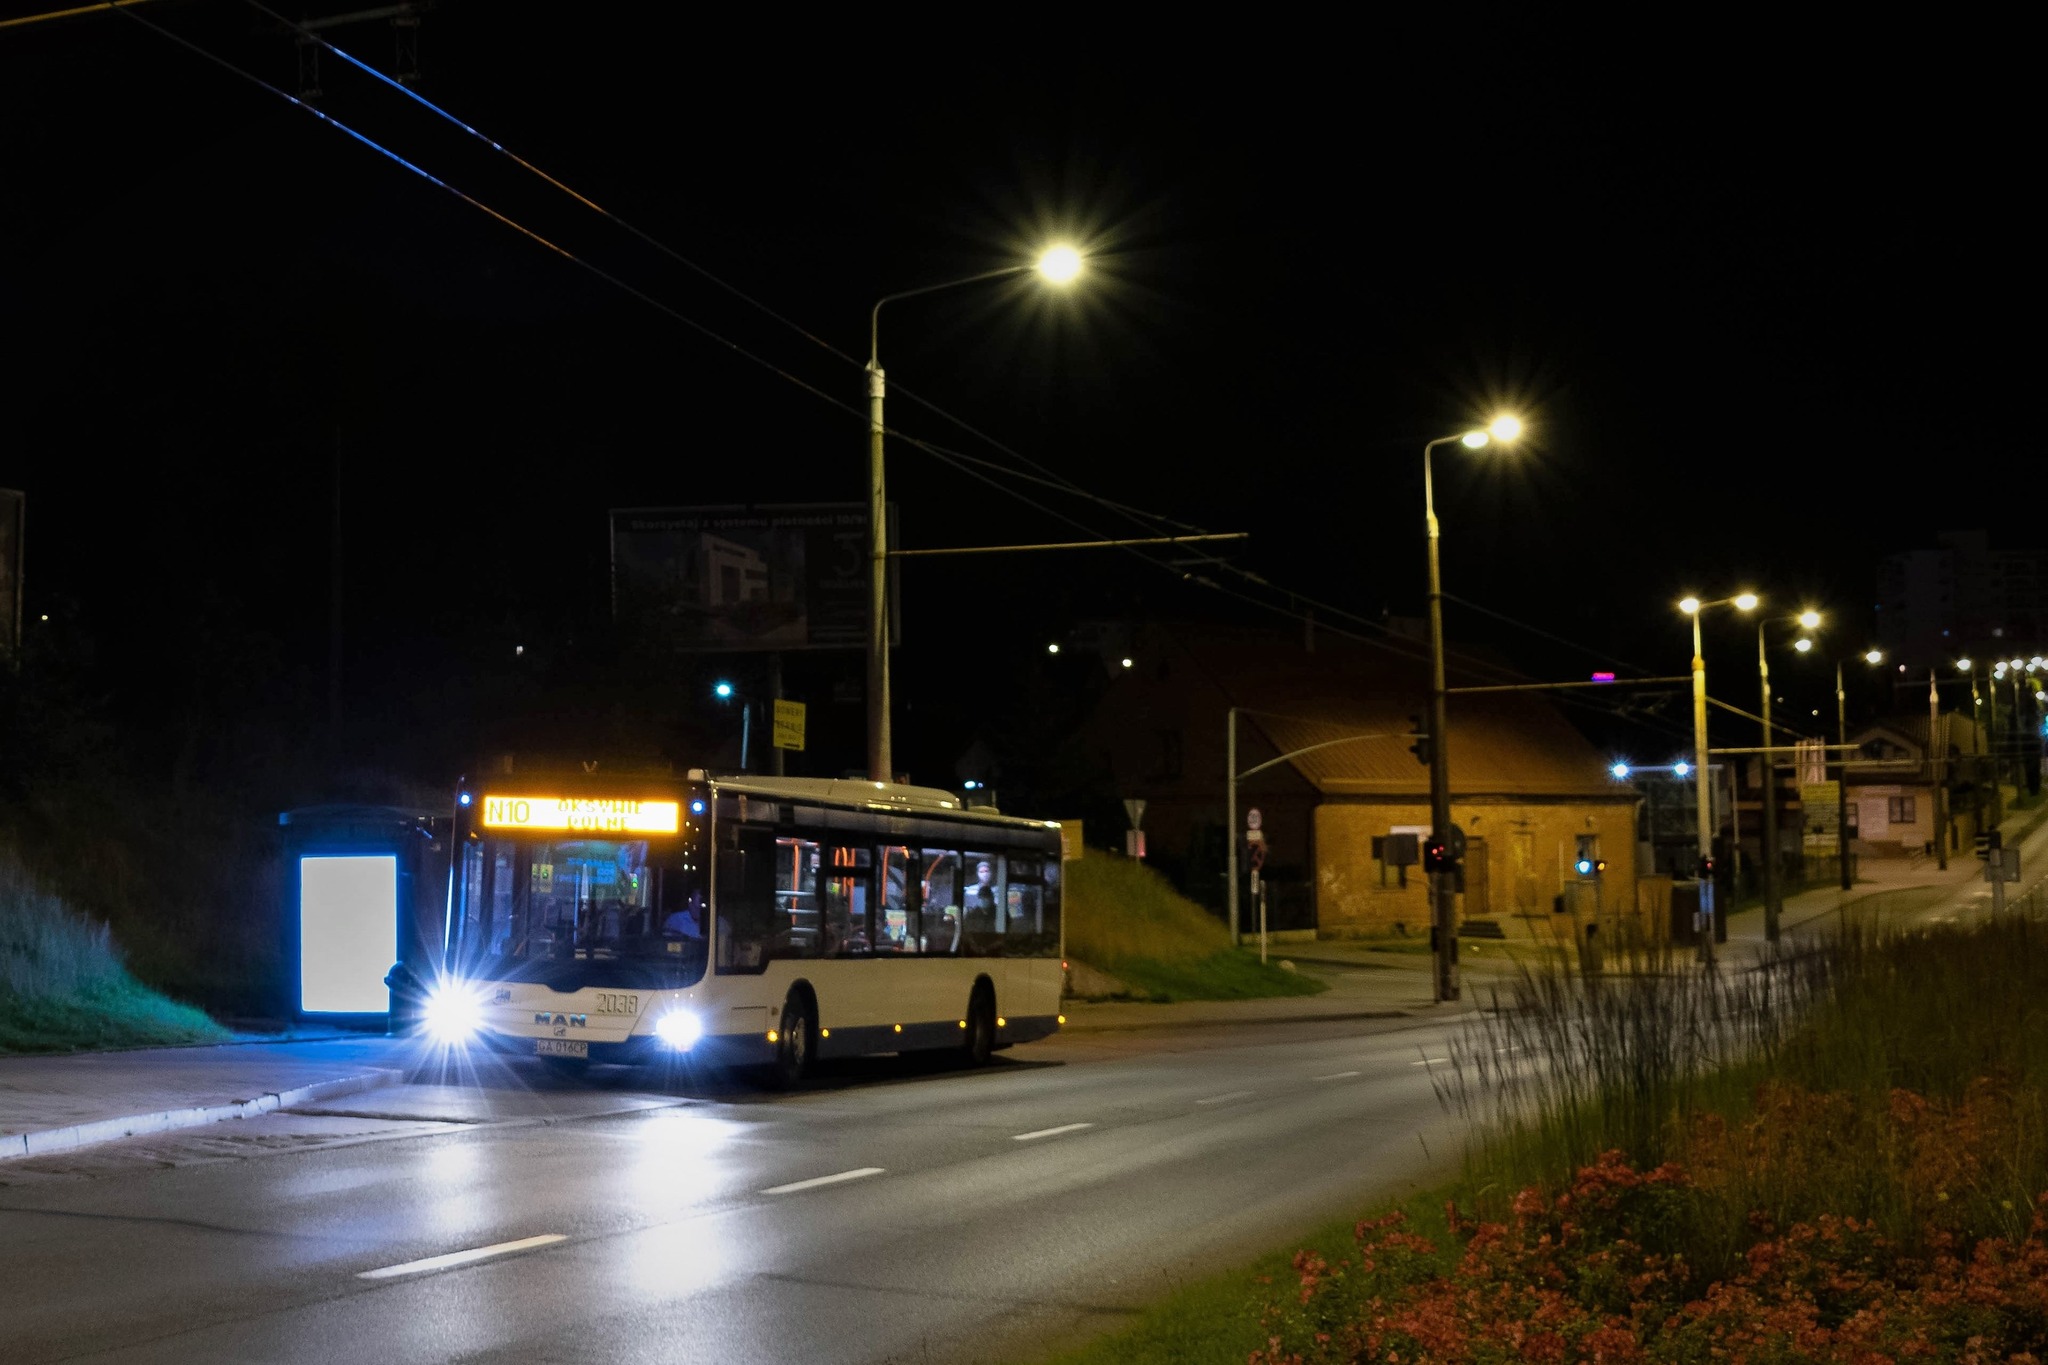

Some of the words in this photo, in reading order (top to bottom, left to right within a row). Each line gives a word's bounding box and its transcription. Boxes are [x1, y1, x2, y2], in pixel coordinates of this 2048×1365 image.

[713, 518, 768, 530] systemu
[488, 799, 530, 824] N10
[534, 1011, 587, 1028] MAN
